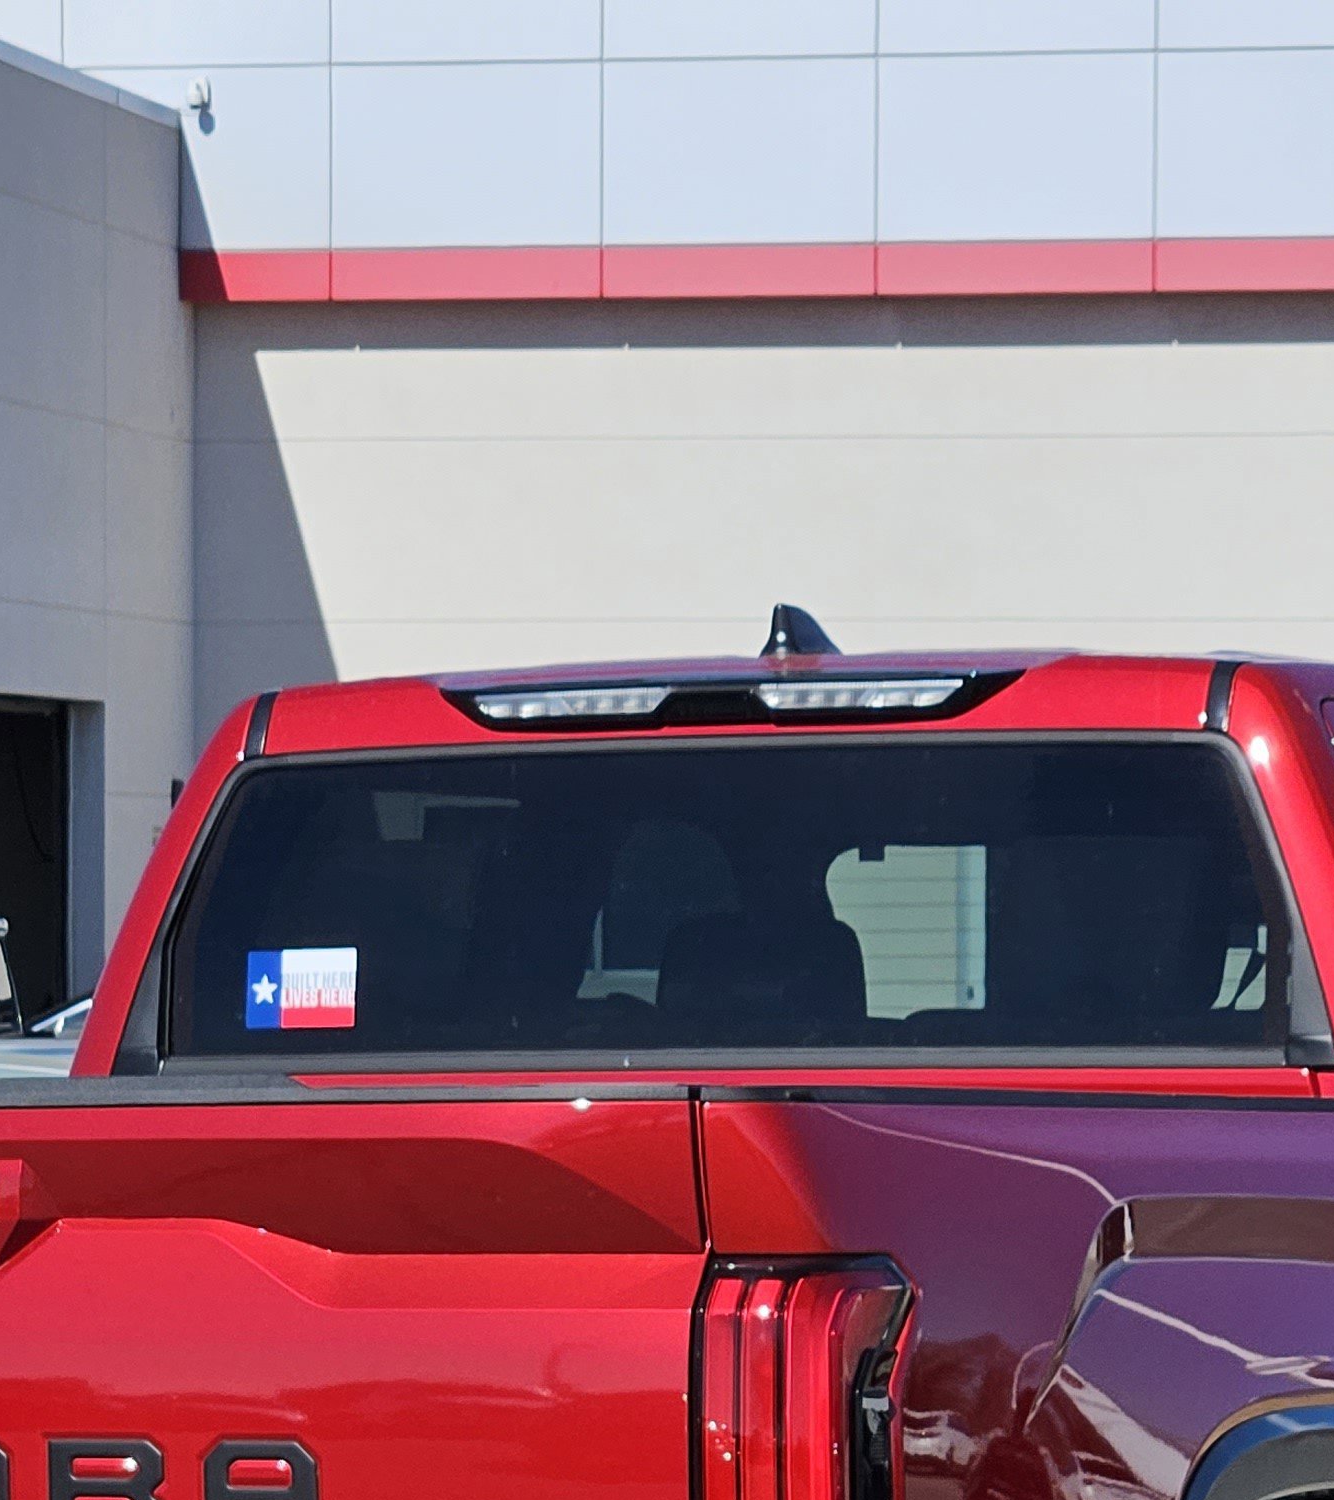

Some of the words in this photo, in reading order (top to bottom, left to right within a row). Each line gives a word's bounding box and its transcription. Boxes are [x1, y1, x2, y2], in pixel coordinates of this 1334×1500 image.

[284, 973, 319, 989] BUILT
[322, 971, 354, 988] HERE
[283, 988, 319, 1008] LIVES
[322, 988, 354, 1008] HERE
